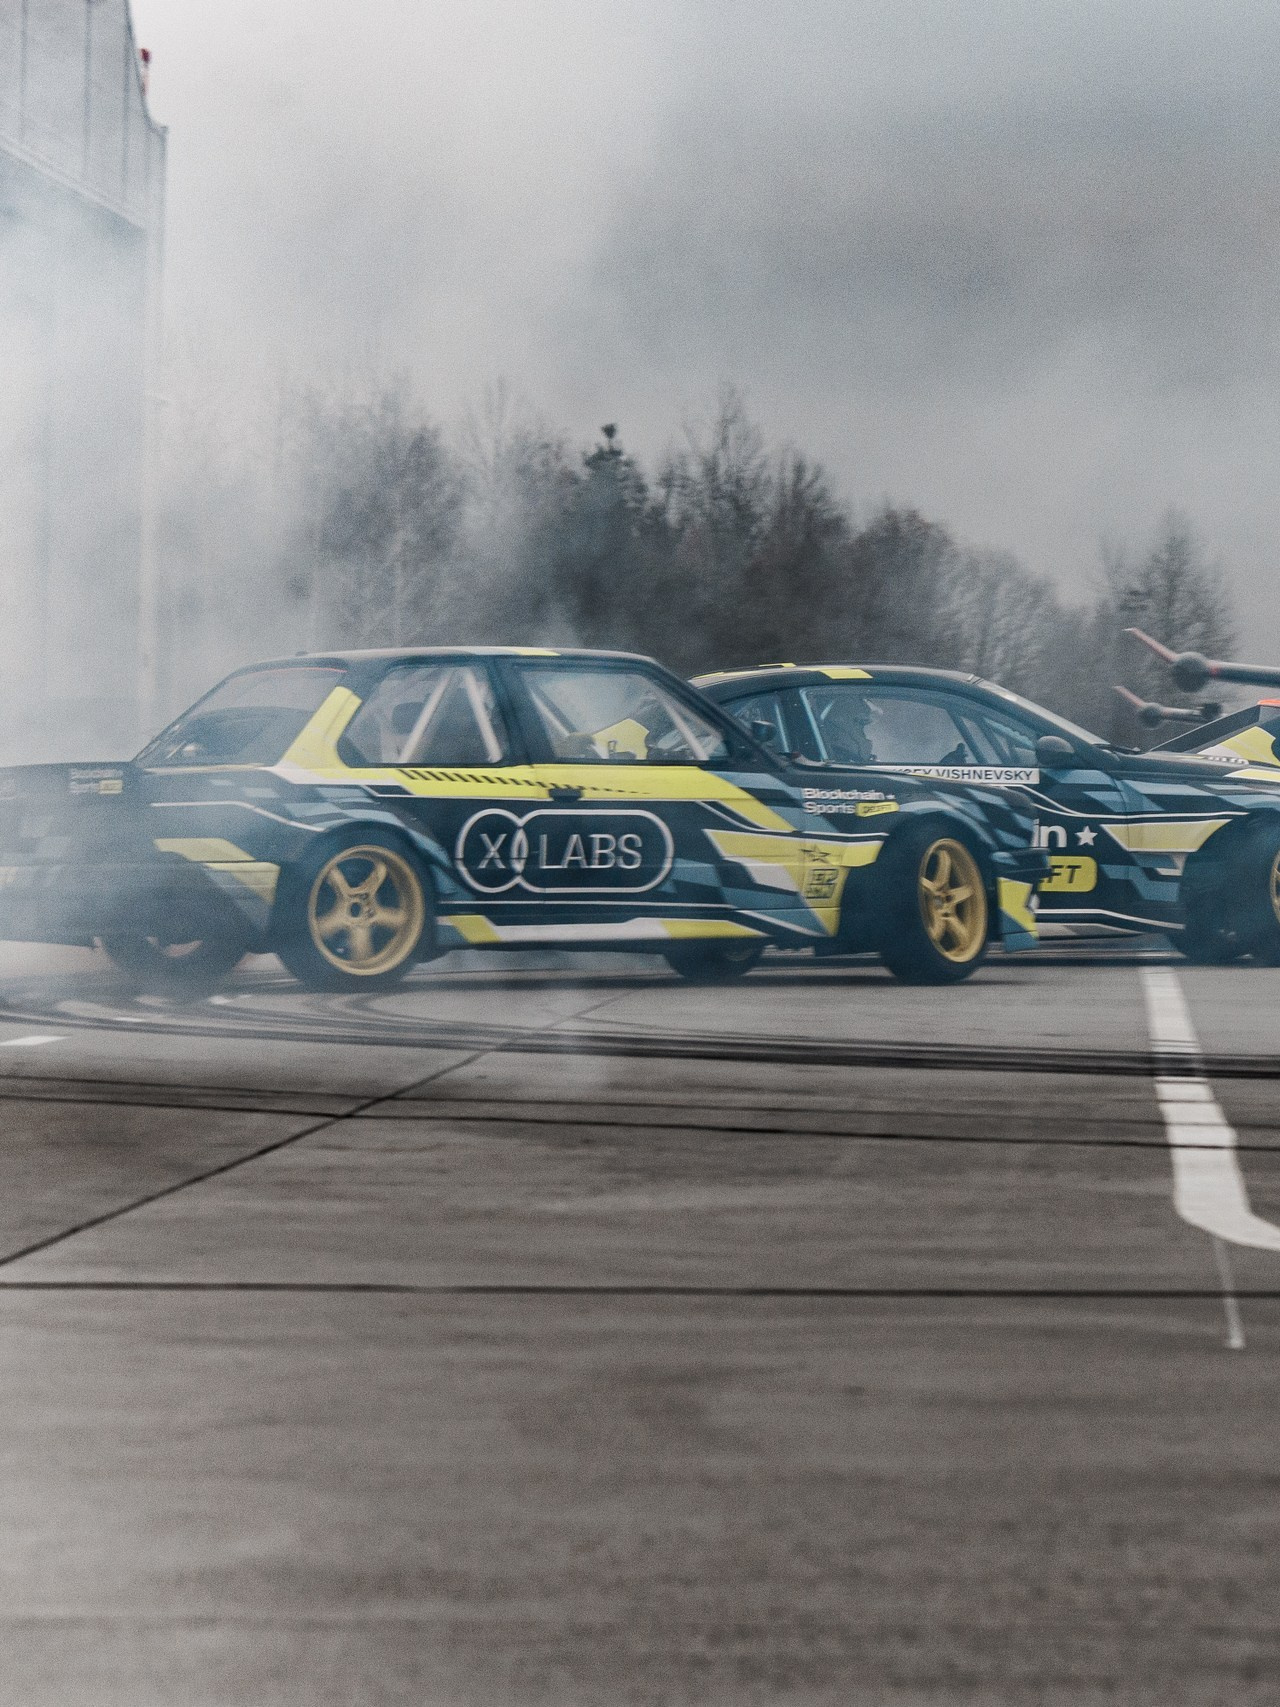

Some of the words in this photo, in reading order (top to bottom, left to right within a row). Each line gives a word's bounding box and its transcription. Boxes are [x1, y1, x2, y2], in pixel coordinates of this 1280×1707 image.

[936, 769, 1033, 780] VISHNEVSKY
[803, 788, 885, 800] Blockchain
[803, 801, 856, 815] Sports
[1031, 818, 1067, 848] in
[478, 833, 507, 868] X
[538, 833, 643, 869] LABS
[1043, 865, 1082, 883] FT
